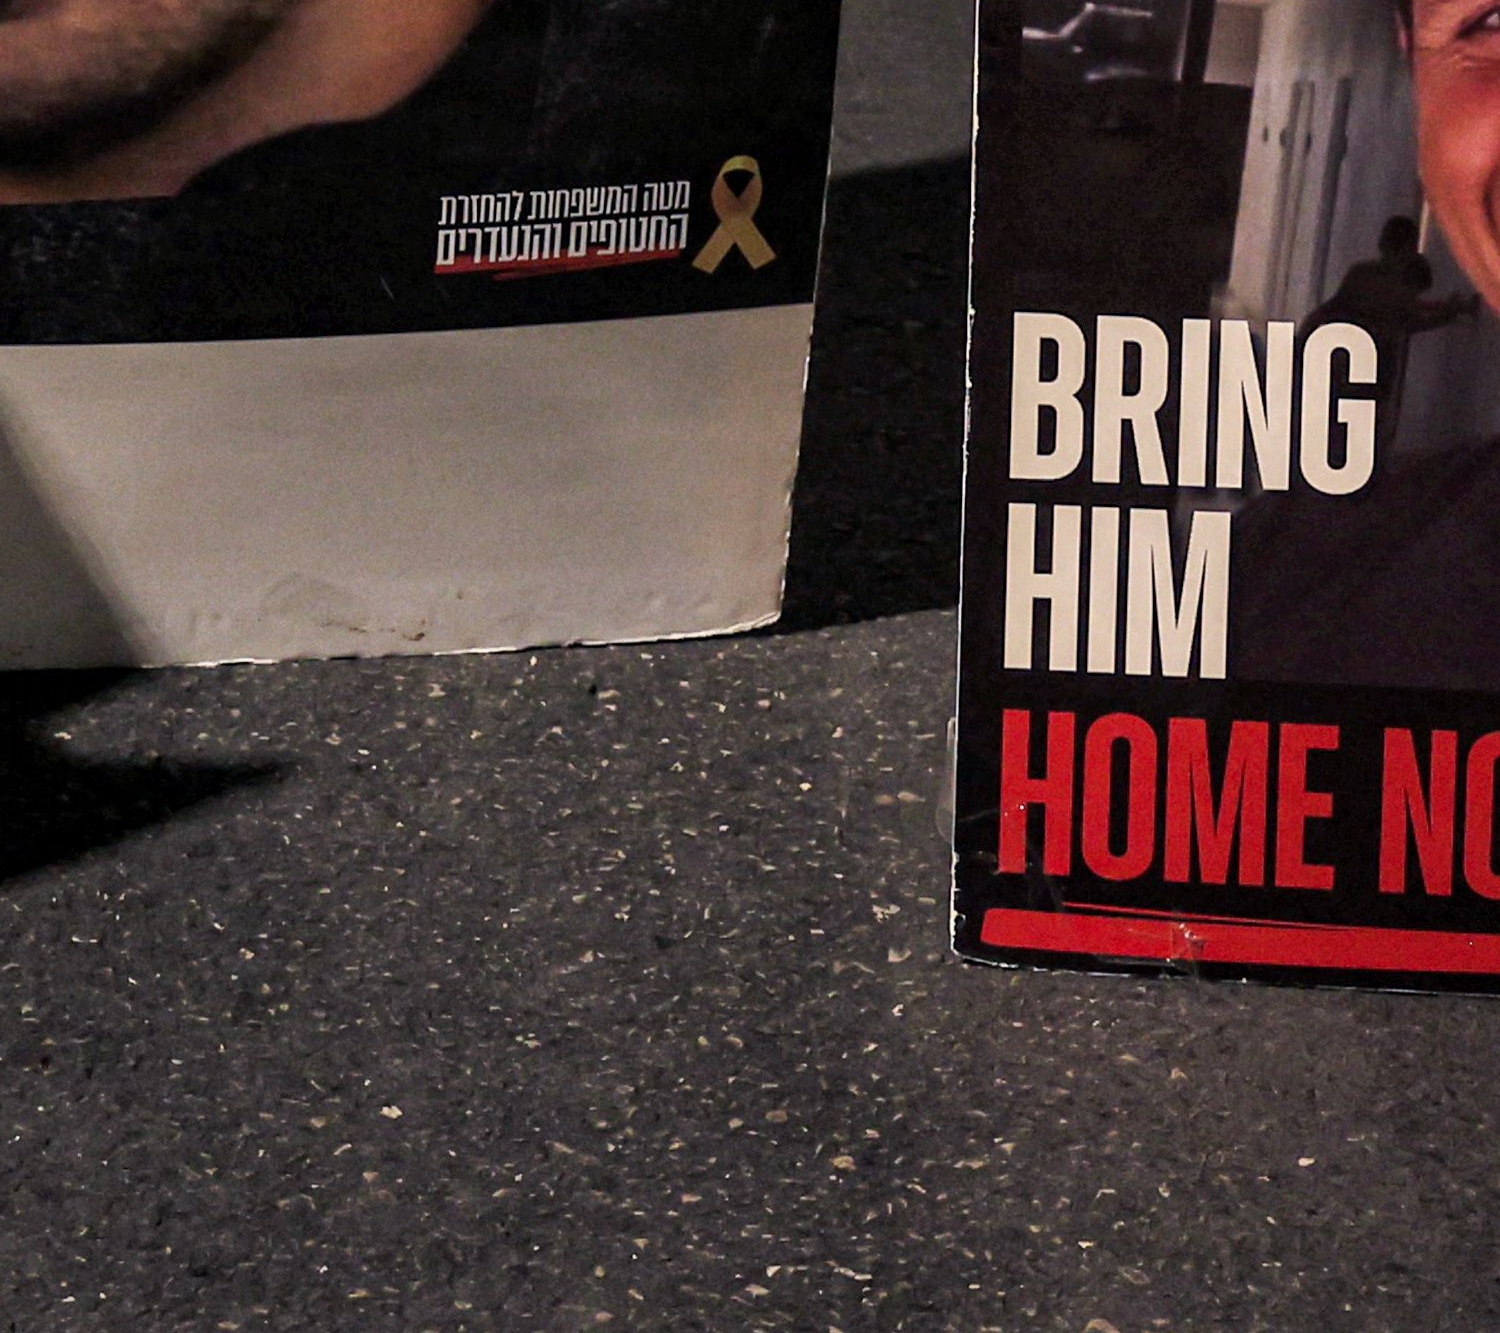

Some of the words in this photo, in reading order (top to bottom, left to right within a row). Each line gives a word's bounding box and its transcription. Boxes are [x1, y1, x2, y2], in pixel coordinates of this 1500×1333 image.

[438, 189, 524, 227] להחזרת
[527, 184, 639, 222] המשפחות
[641, 179, 692, 212] מטה
[435, 222, 563, 266] והנעדרים
[567, 213, 690, 259] החטופים
[1008, 310, 1379, 496] BRING
[1002, 501, 1232, 681] HIM
[997, 707, 1343, 892] HOME
